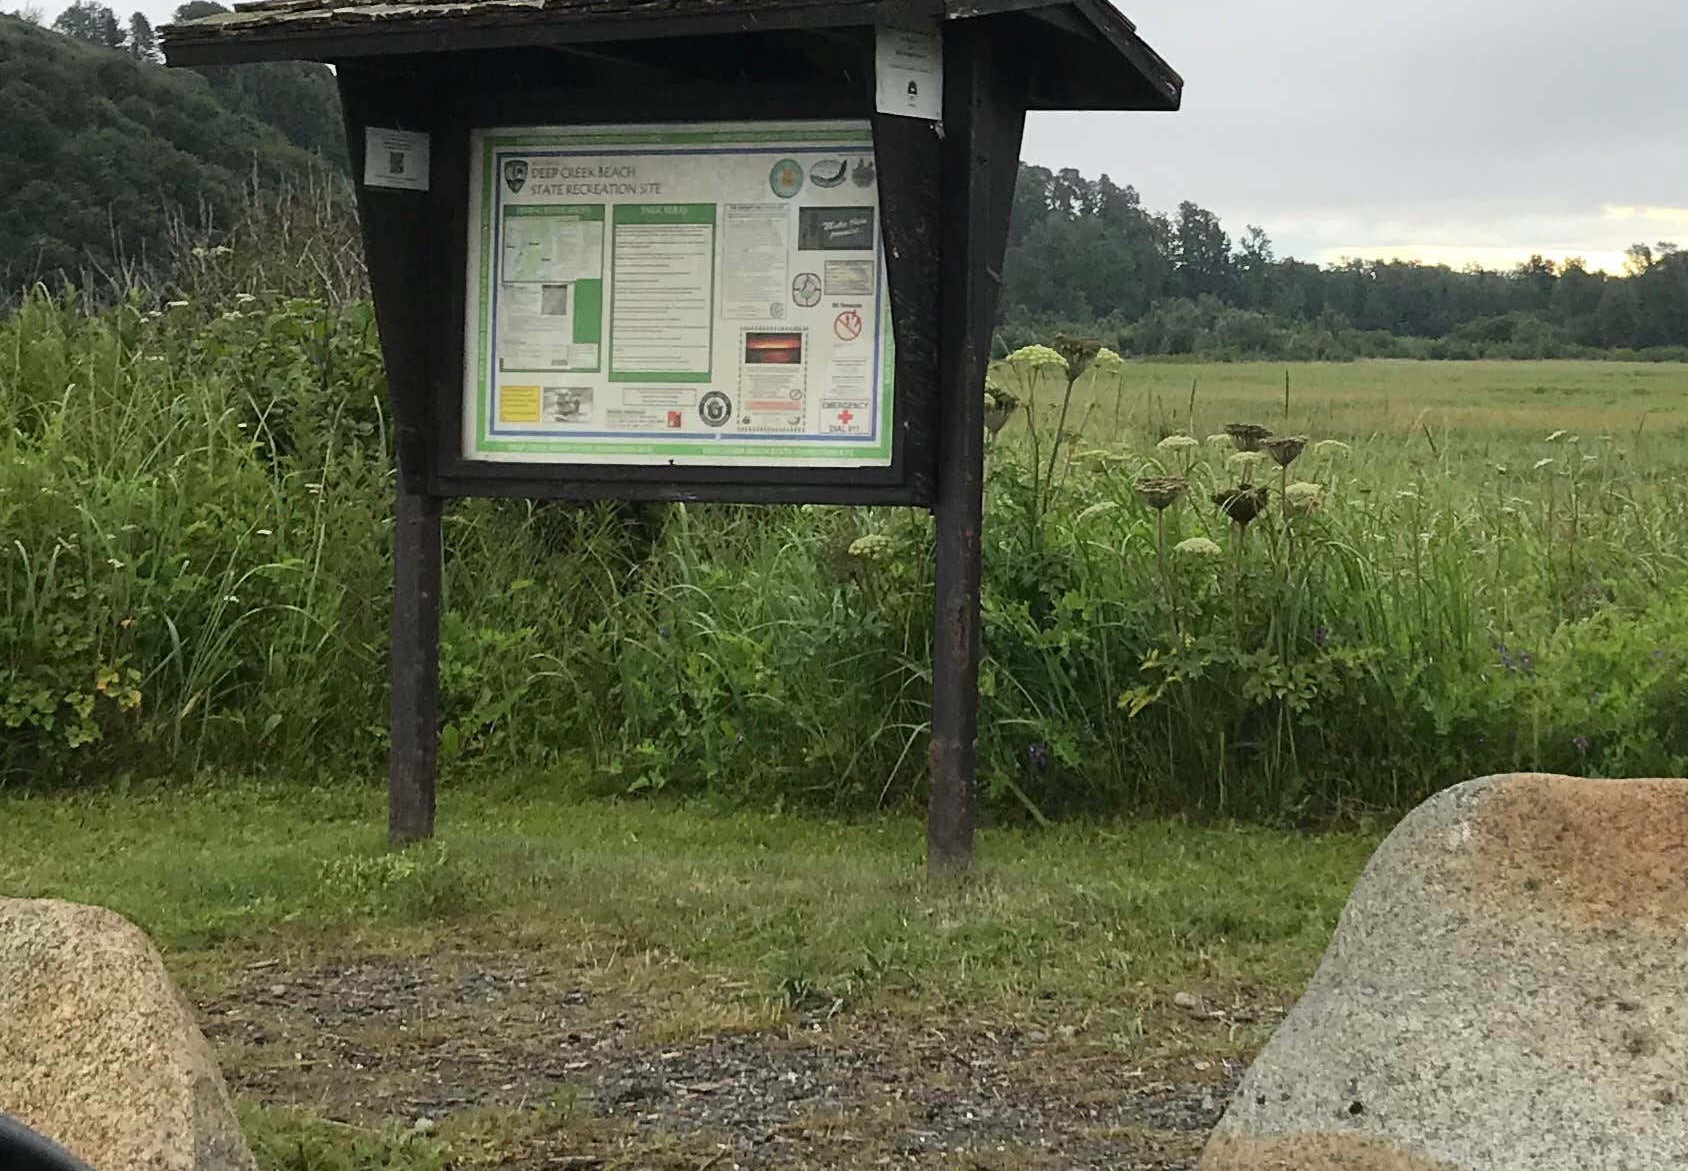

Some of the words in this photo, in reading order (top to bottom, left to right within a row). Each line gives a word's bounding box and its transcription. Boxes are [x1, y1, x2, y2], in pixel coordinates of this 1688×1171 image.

[561, 166, 594, 178] CREEK
[598, 166, 637, 178] BEACH
[531, 183, 563, 195] STATE
[566, 183, 637, 195] RECREATION
[639, 183, 662, 195] SITE
[822, 401, 869, 409] EMERGENCY
